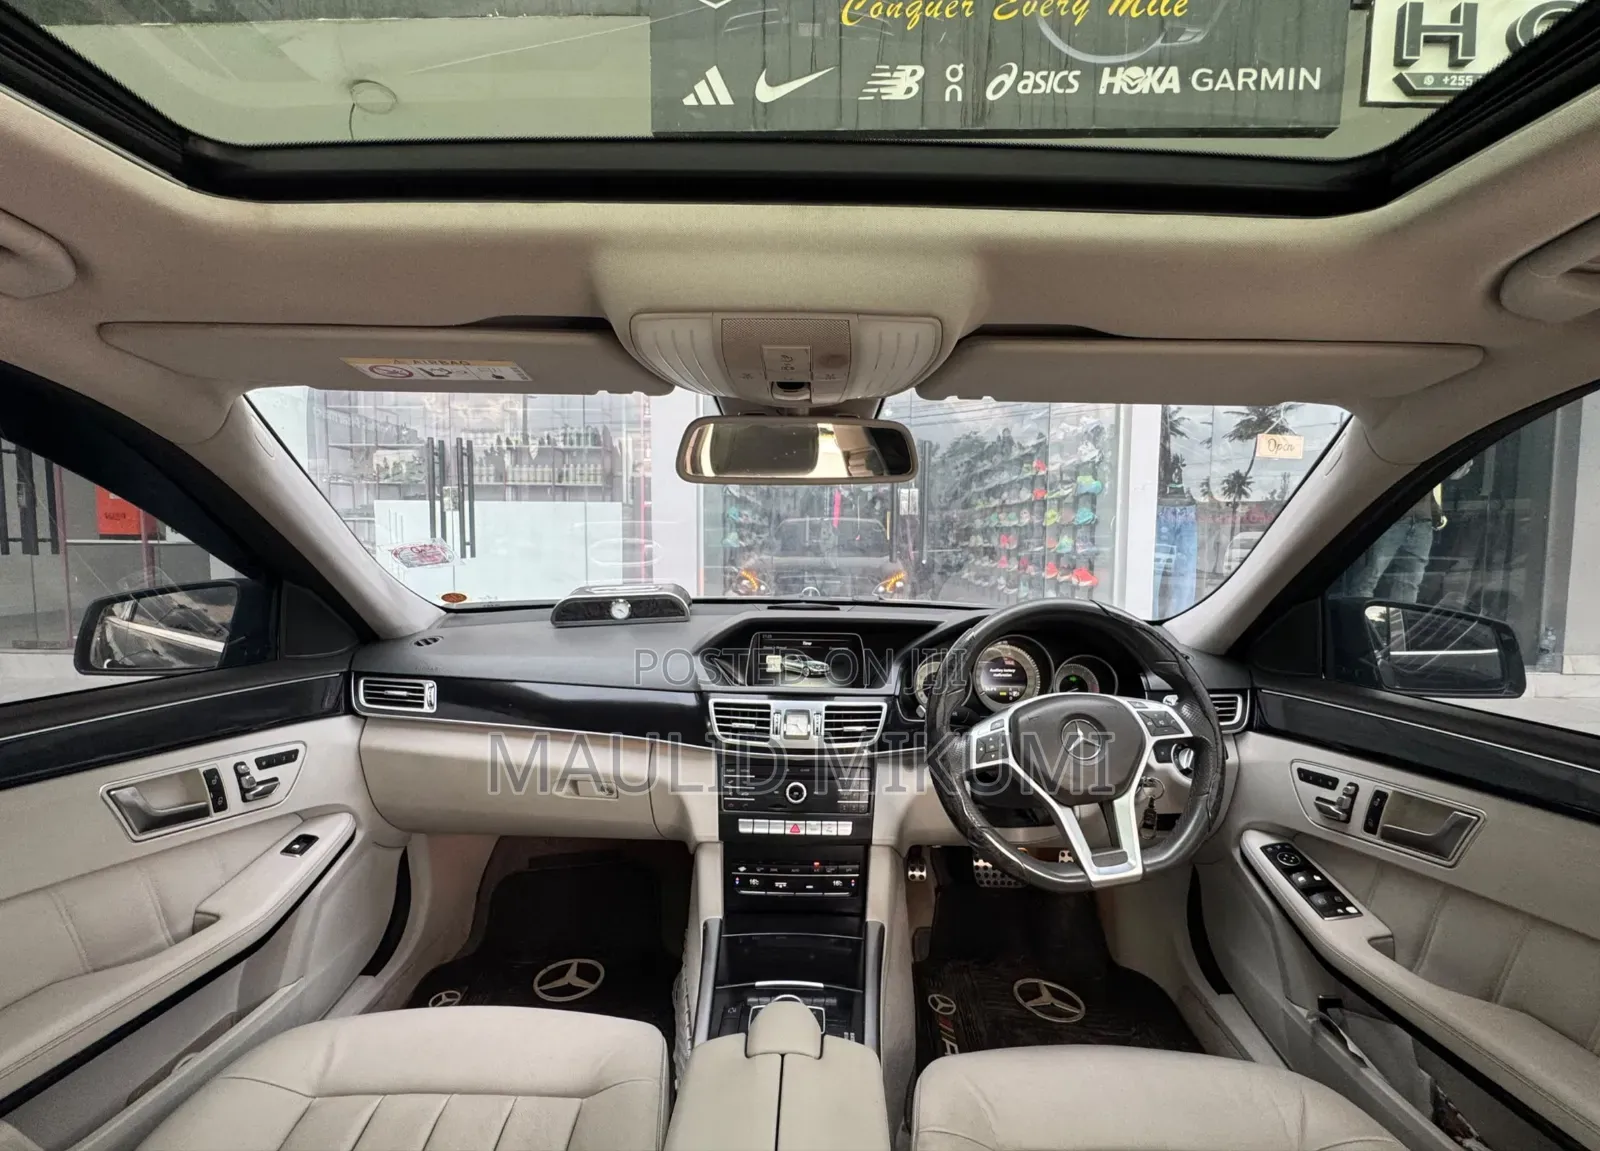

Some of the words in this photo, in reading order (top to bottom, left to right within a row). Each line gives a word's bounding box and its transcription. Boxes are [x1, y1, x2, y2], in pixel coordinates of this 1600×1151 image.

[841, 0, 974, 30] Conquer
[993, 0, 1089, 26] Every
[1108, 0, 1189, 17] Mile
[1098, 66, 1181, 95] HOKA
[1191, 67, 1322, 92] GARMIN
[1442, 74, 1474, 87] +255
[1267, 438, 1296, 455] Open
